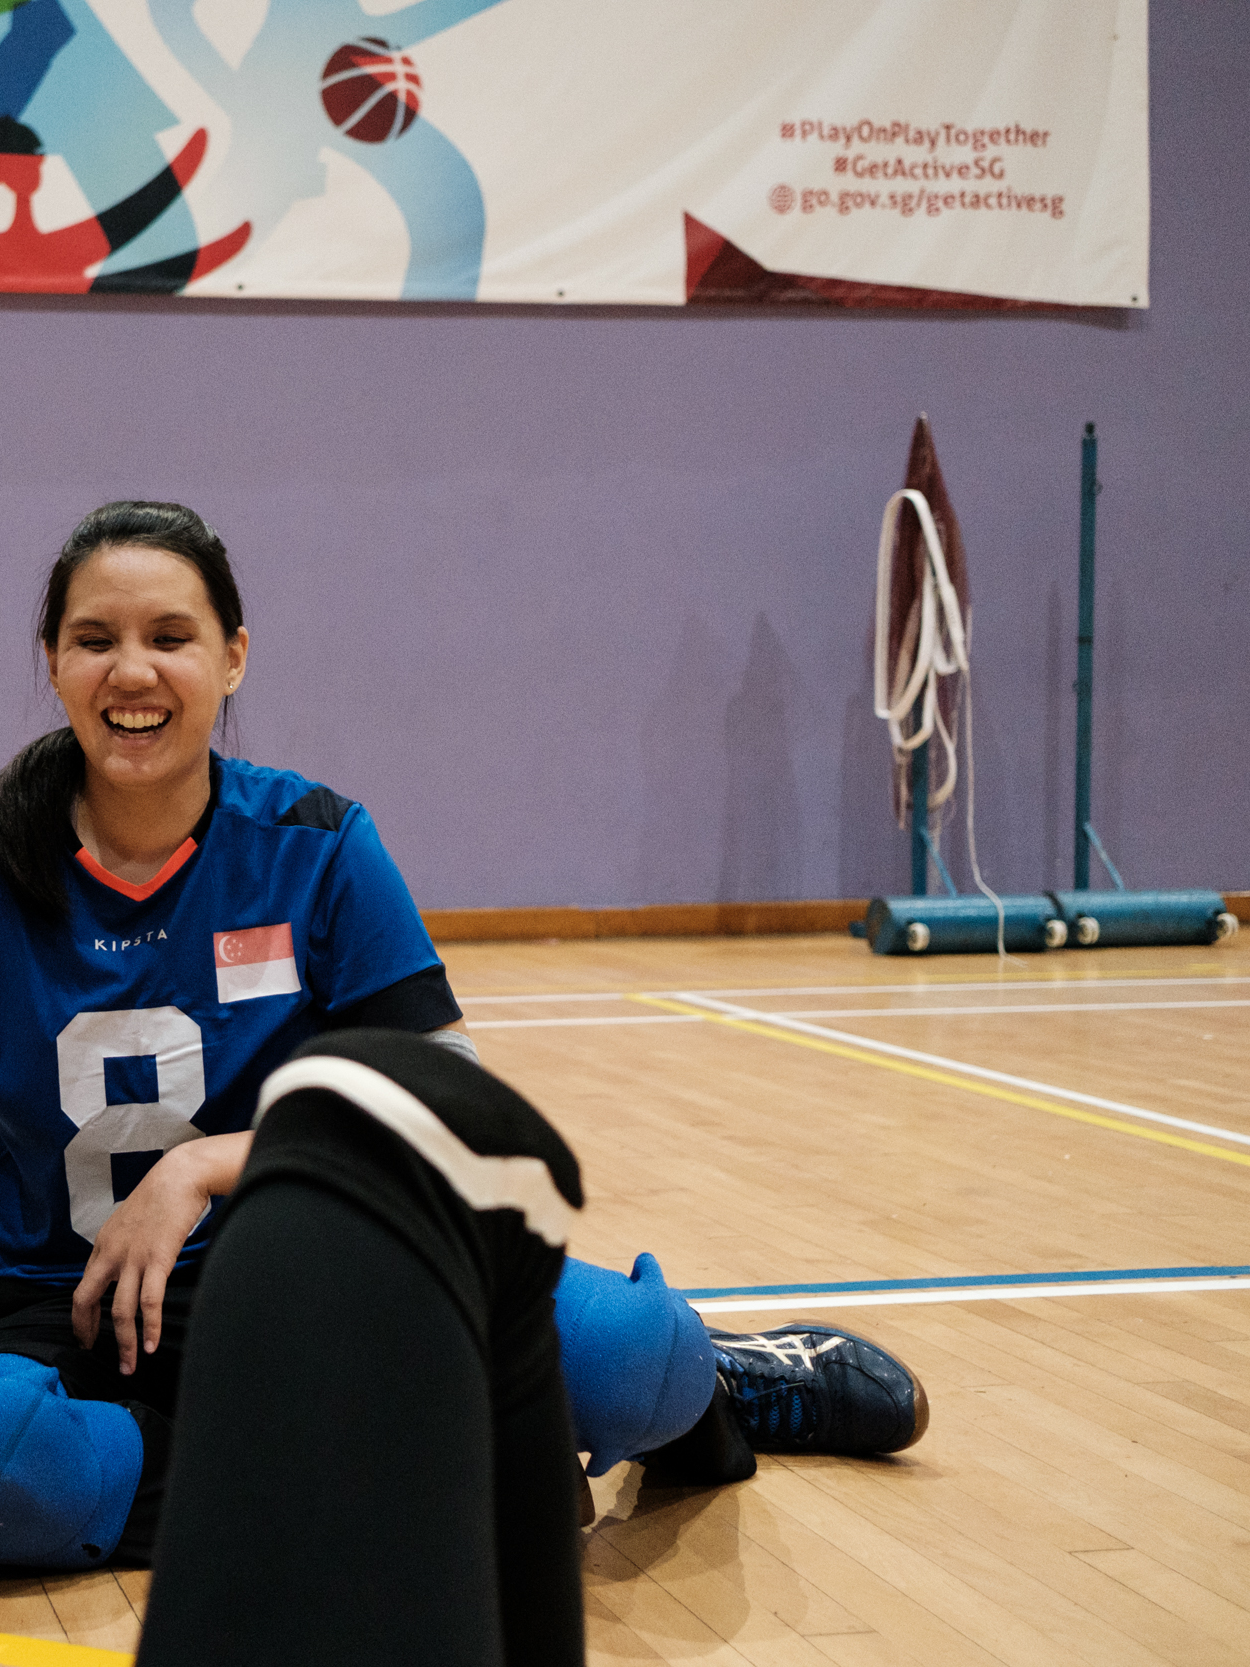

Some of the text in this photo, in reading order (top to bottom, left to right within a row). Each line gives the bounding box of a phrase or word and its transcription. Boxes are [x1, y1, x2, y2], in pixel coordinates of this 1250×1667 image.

[780, 119, 1051, 152] #PlayOnPlayTogether
[834, 154, 1006, 181] #GetActiveSG
[800, 186, 1066, 220] go.gov.sg/getactivesg
[94, 928, 168, 952] KIPSTA
[56, 1005, 212, 1247] 8
